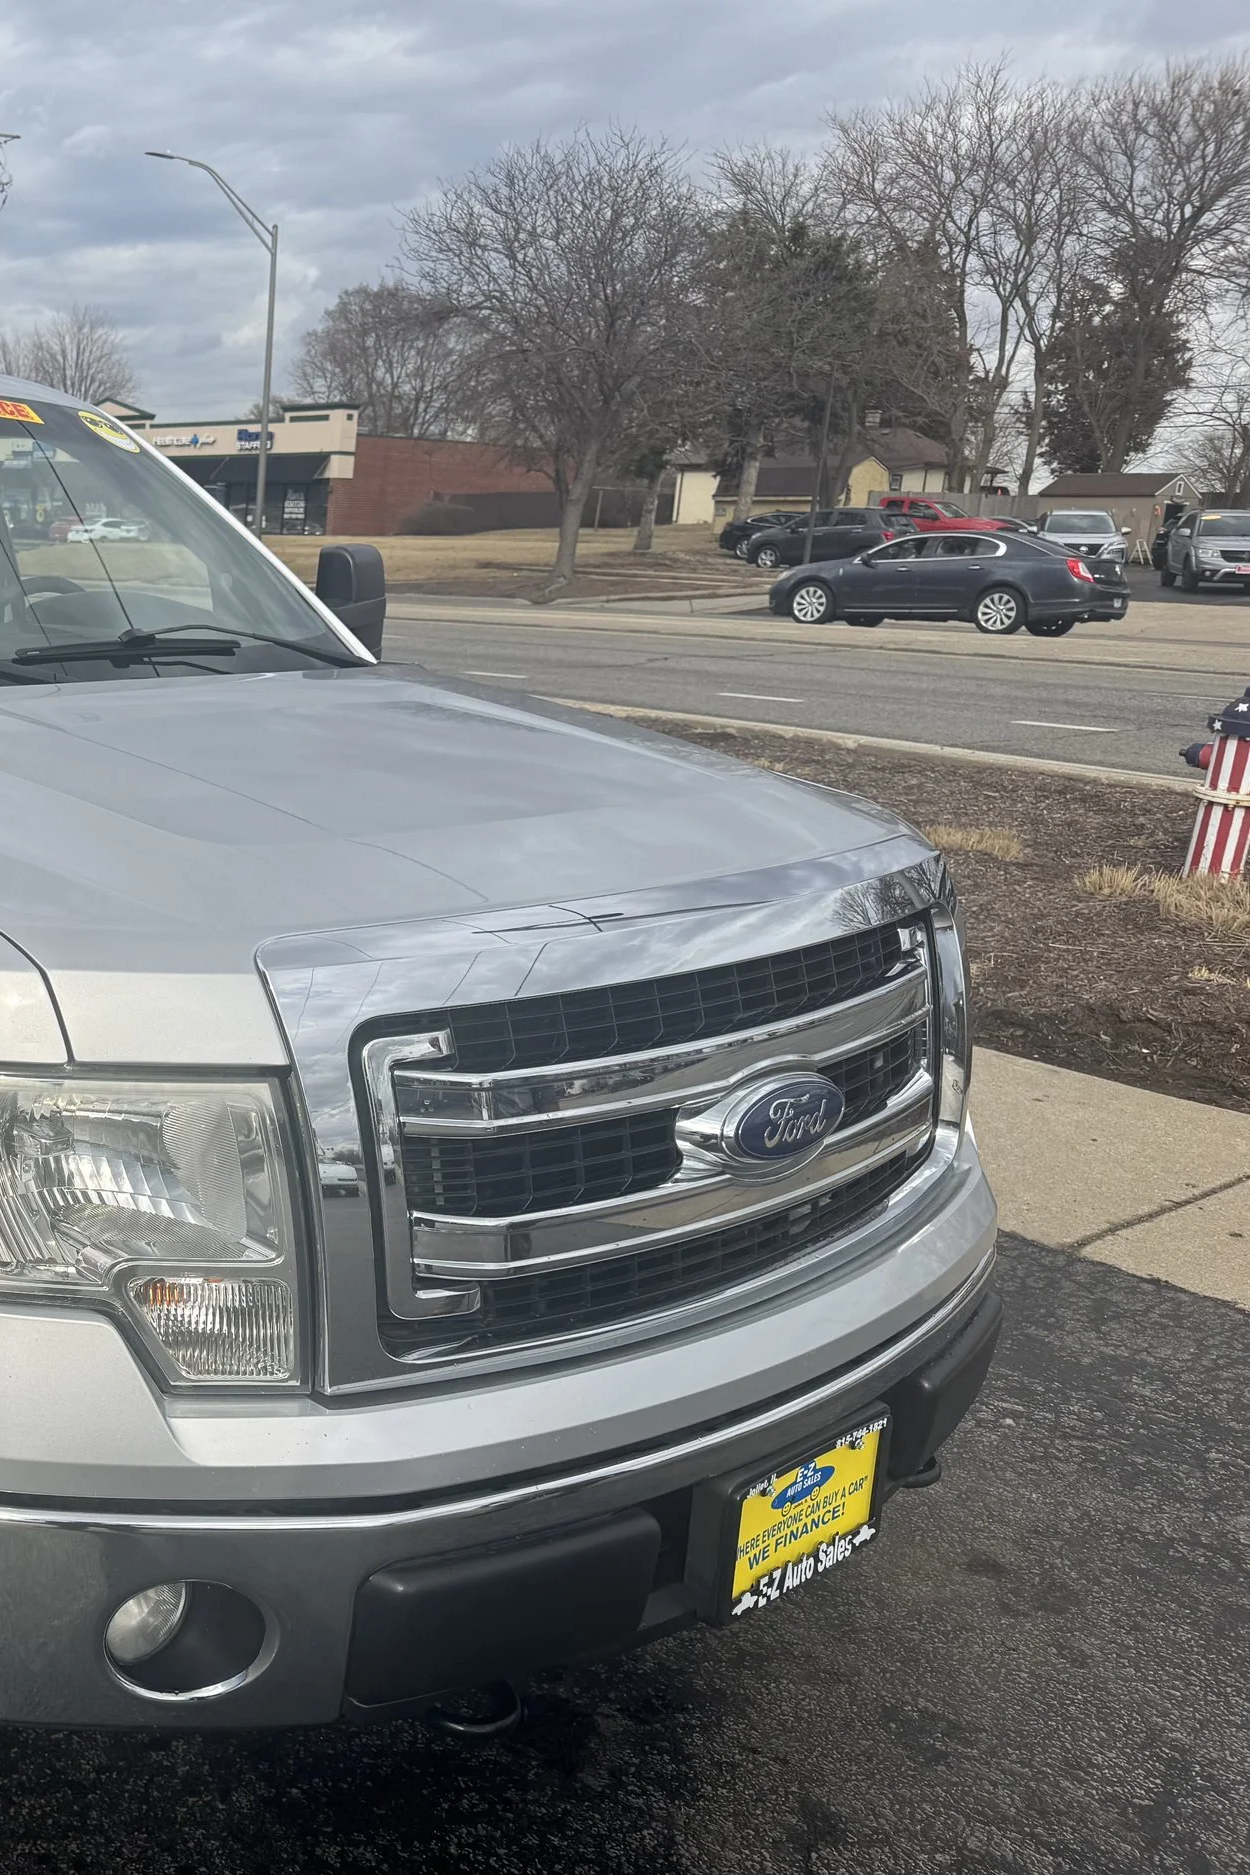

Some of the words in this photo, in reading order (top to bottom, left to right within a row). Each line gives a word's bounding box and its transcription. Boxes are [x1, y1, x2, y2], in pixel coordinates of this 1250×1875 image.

[764, 1094, 827, 1148] Ford
[786, 1481, 803, 1498] AUTO
[803, 1471, 821, 1490] SALES
[796, 1461, 815, 1483] E-Z
[748, 1544, 770, 1570] WE
[774, 1502, 846, 1553] FINANCE!
[761, 1509, 804, 1544] EVERYONE
[805, 1501, 822, 1518] CAN
[822, 1490, 840, 1506] BUY
[840, 1486, 846, 1500] A
[783, 1555, 815, 1593] Auto
[817, 1535, 852, 1573] Sales
